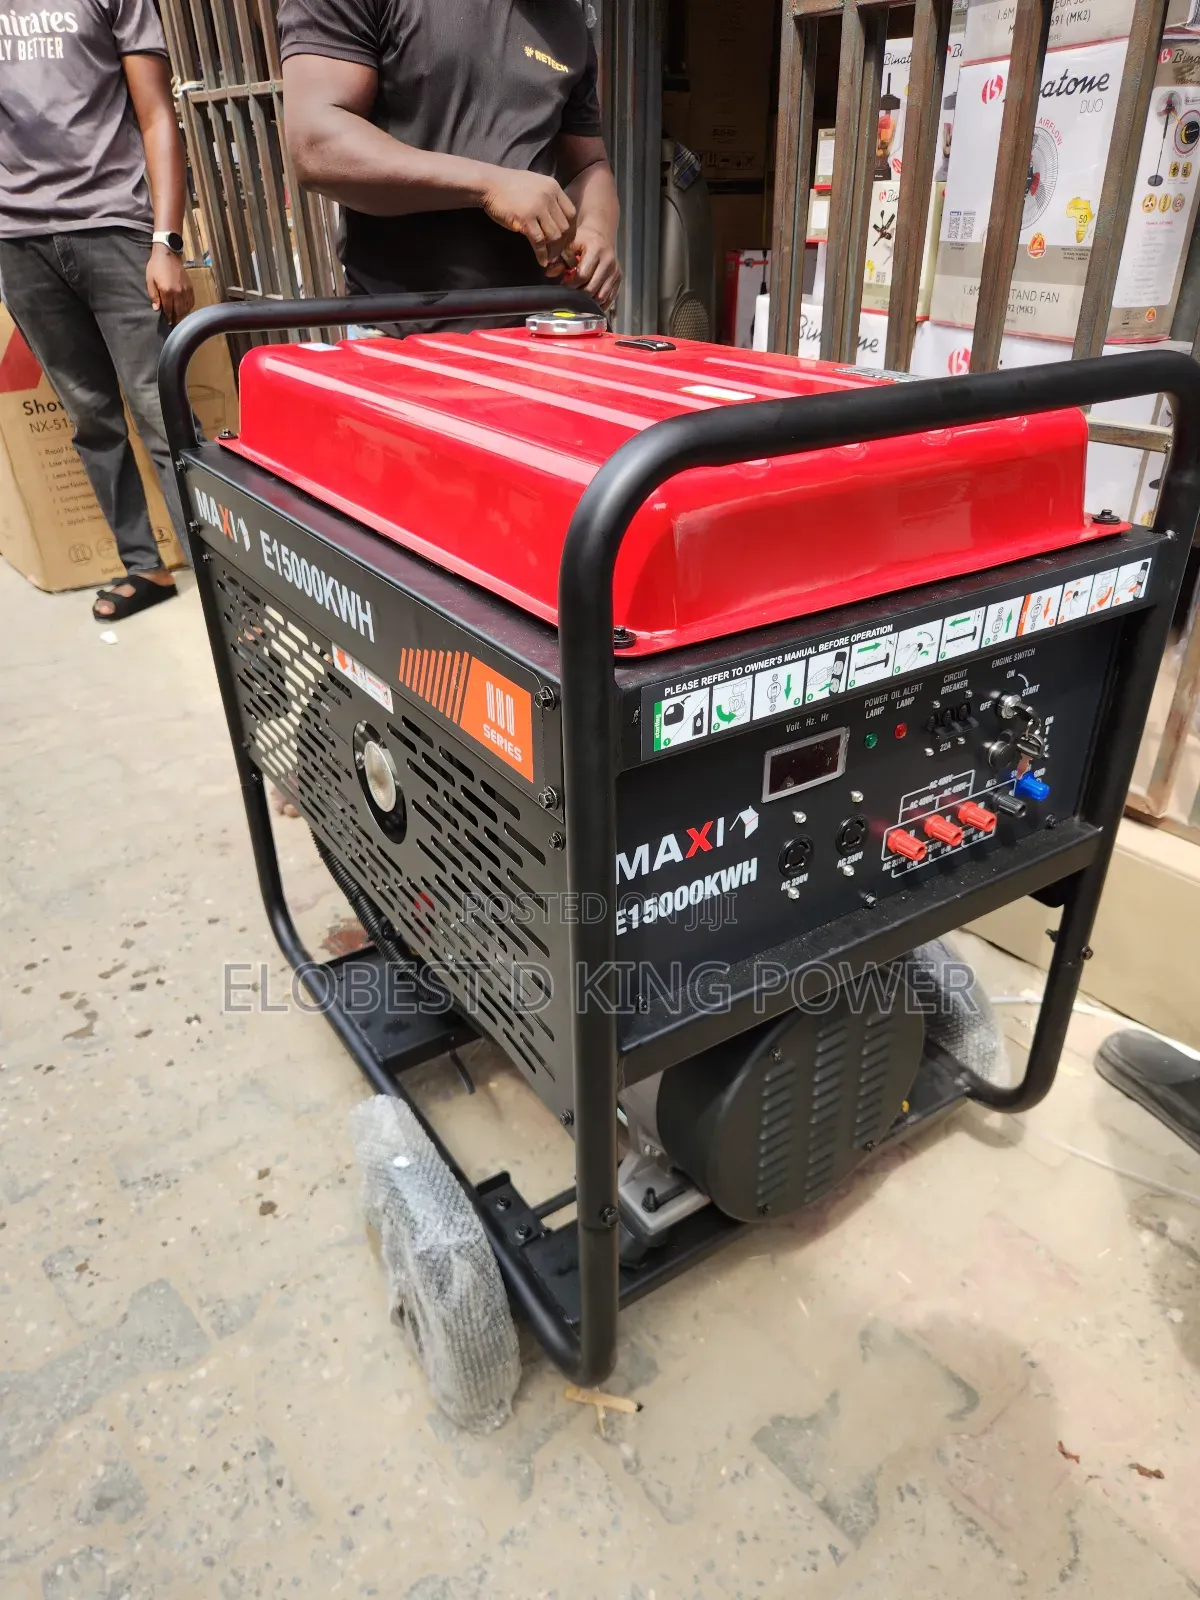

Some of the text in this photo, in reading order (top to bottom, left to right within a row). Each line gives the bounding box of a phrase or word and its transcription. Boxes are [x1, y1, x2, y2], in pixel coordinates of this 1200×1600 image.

[17, 37, 64, 61] BETTER
[1079, 98, 1104, 114] DUO
[1078, 214, 1088, 224] 50
[1011, 288, 1037, 302] TAND
[1039, 291, 1060, 304] FAN
[194, 487, 375, 643] MAXI E15000KWH
[664, 624, 893, 697] PLEASE REFER TO OWNER'S MANUAL BEFORE OPERATION
[992, 648, 1036, 669] ENGINE SWITCH
[943, 668, 968, 683] CIRCUIT
[1006, 668, 1016, 679] ON
[890, 682, 924, 700] OIL ALERT
[940, 679, 969, 695] BREAKER
[1022, 684, 1040, 697] START
[864, 693, 888, 709] POWER
[896, 696, 915, 710] LAMP
[980, 700, 992, 711] OFF
[821, 713, 829, 722] Hr
[865, 706, 885, 719] LAMP
[483, 723, 523, 763] SERIES
[616, 816, 725, 885] MAXI
[837, 857, 847, 868] AC
[846, 851, 864, 865] 230V
[781, 879, 791, 891] AC
[791, 873, 808, 887] 230V
[616, 857, 758, 936] E15000KWH
